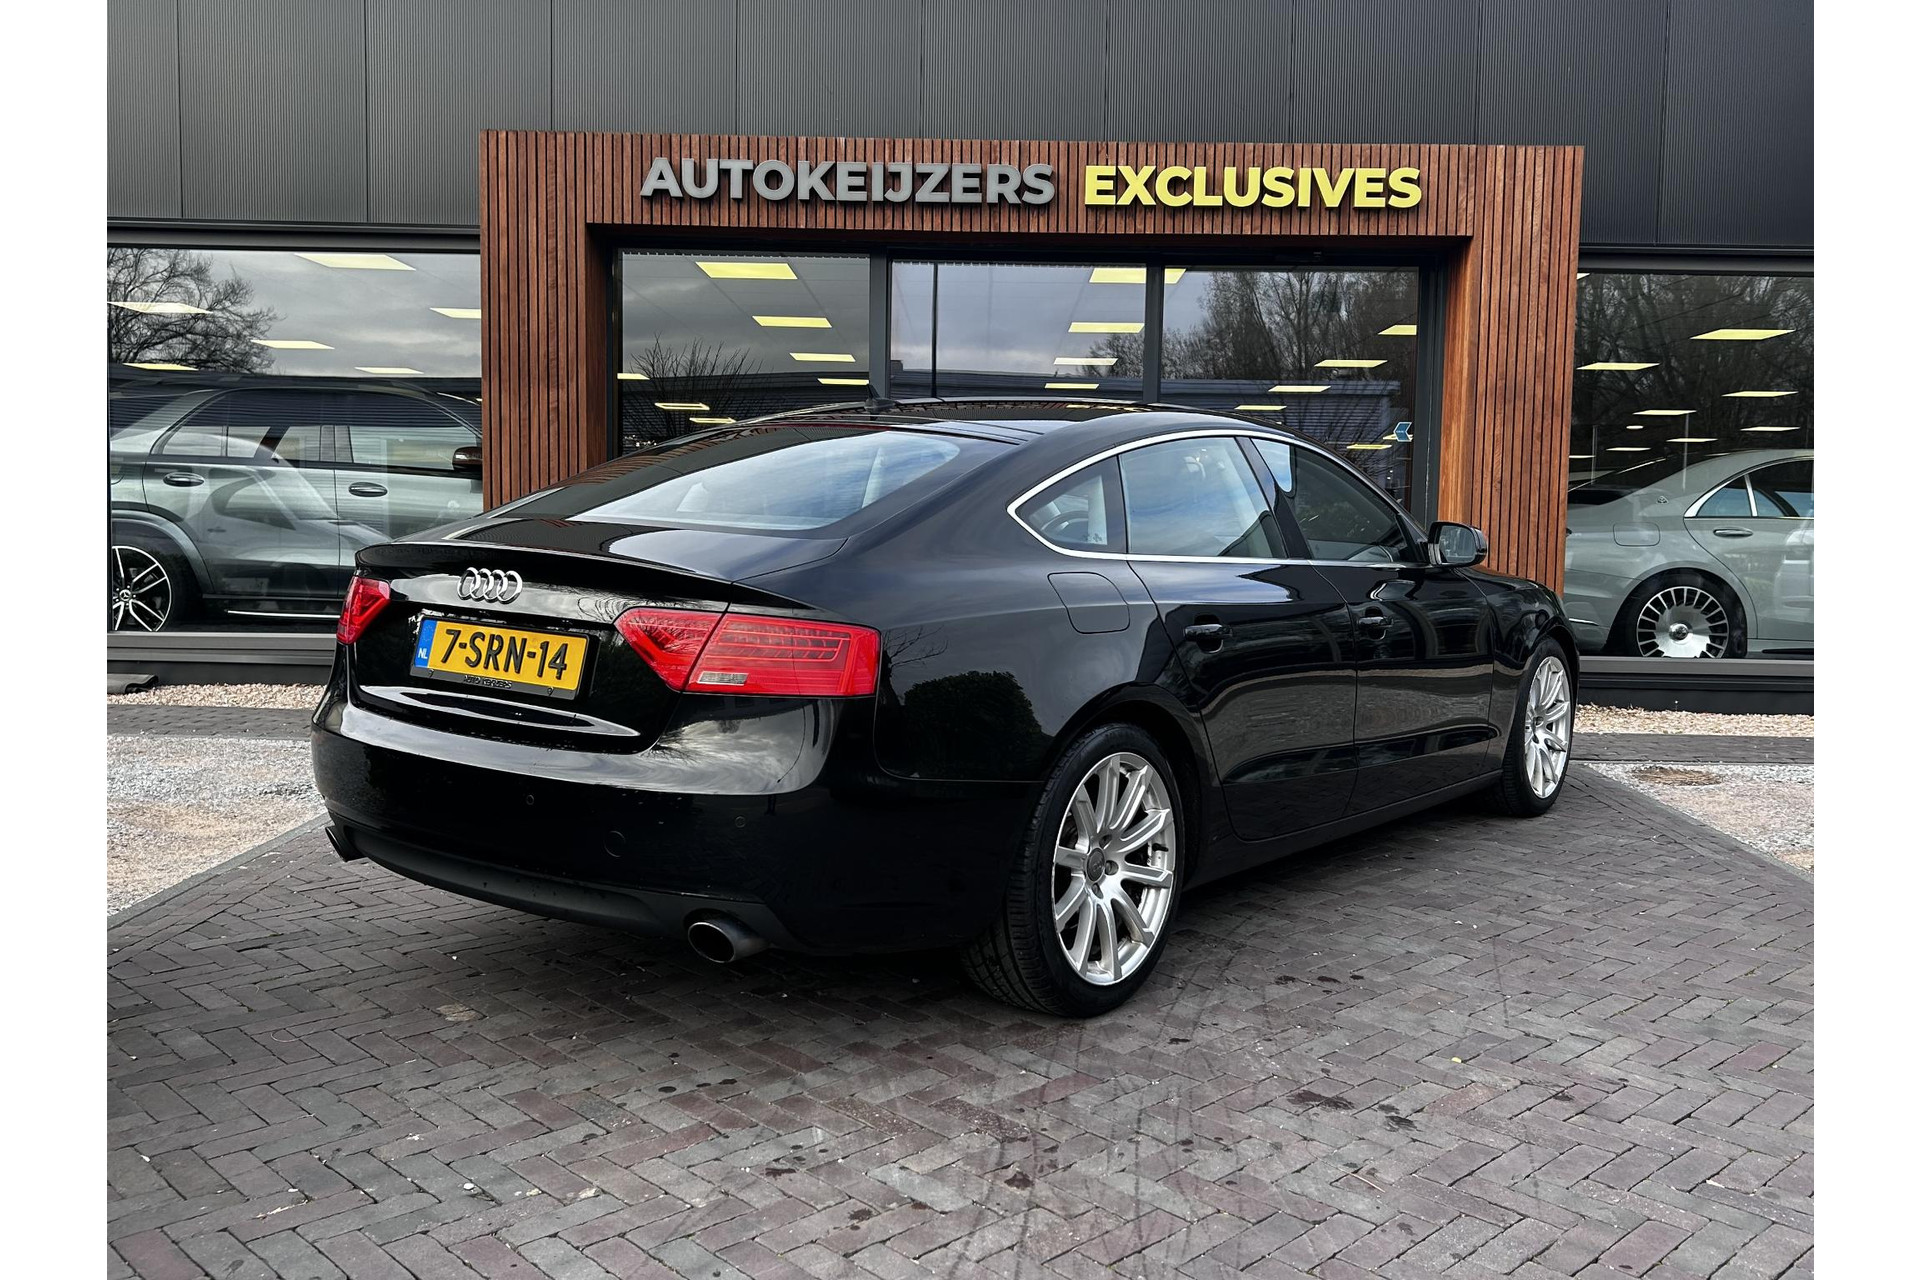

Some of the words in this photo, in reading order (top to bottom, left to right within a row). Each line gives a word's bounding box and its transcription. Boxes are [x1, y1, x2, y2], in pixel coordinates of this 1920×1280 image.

[640, 157, 1056, 205] AUTOKEIJZERS
[1085, 165, 1423, 208] EXCLUSIVES
[417, 648, 428, 660] NL
[441, 628, 569, 680] 7-SRN-14
